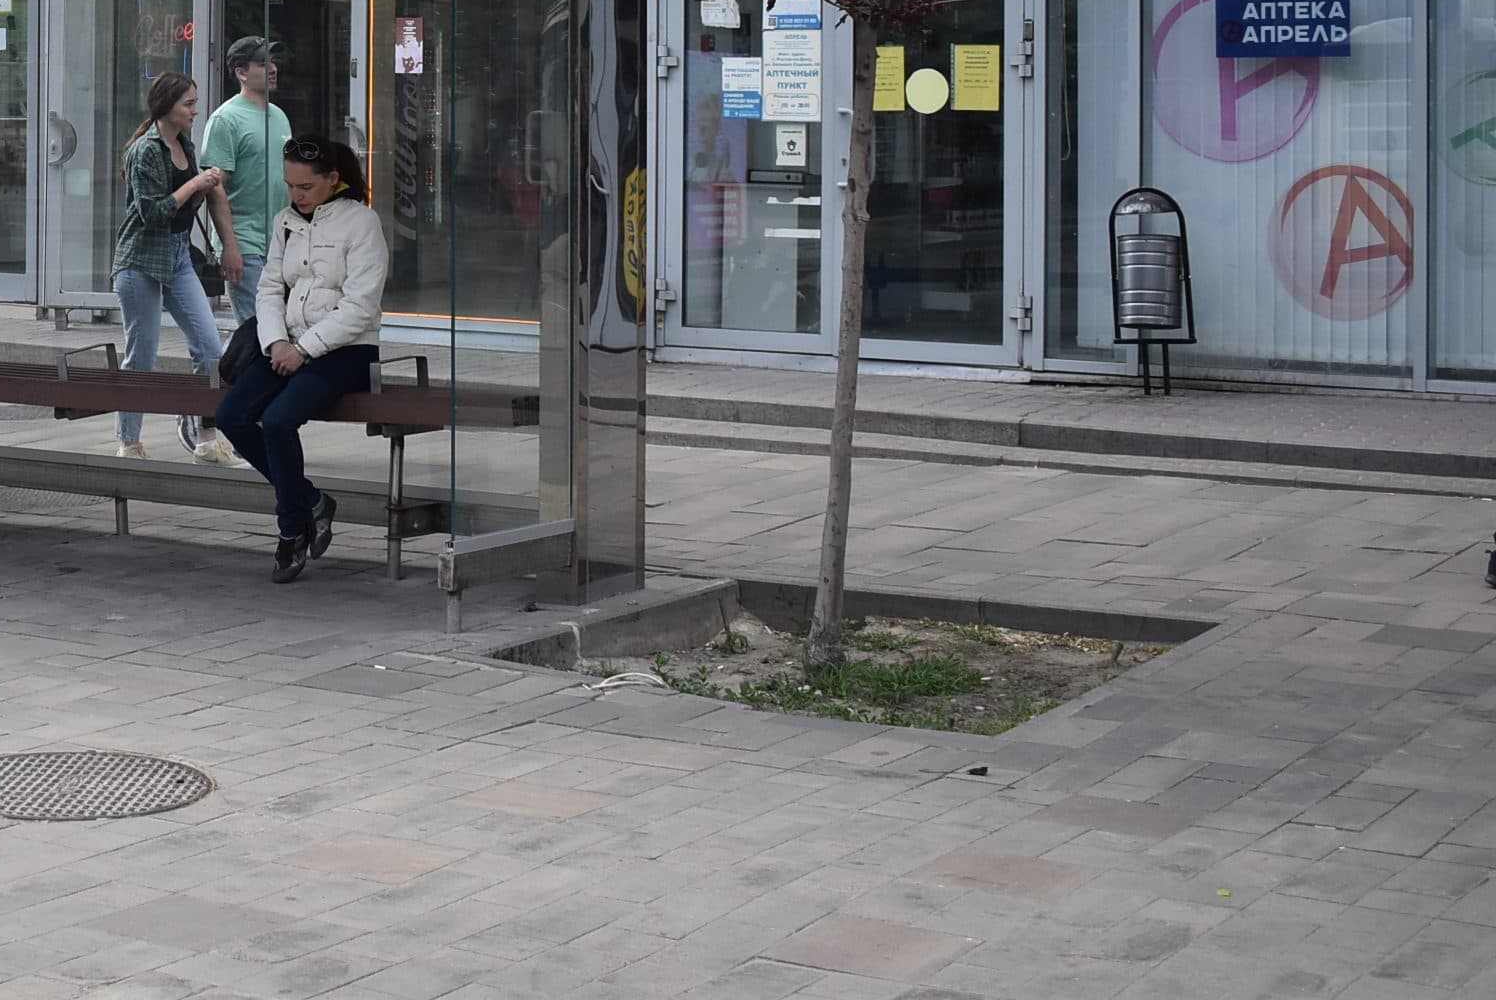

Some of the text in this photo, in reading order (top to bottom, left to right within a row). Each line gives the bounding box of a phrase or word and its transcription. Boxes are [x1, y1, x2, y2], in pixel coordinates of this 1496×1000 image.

[1242, 1, 1346, 20] АПТЕКА
[1241, 24, 1348, 44] АПРЕЛЬ
[766, 68, 819, 78] АПТЕЧНЫЙ
[777, 81, 808, 90] ПУНКТ
